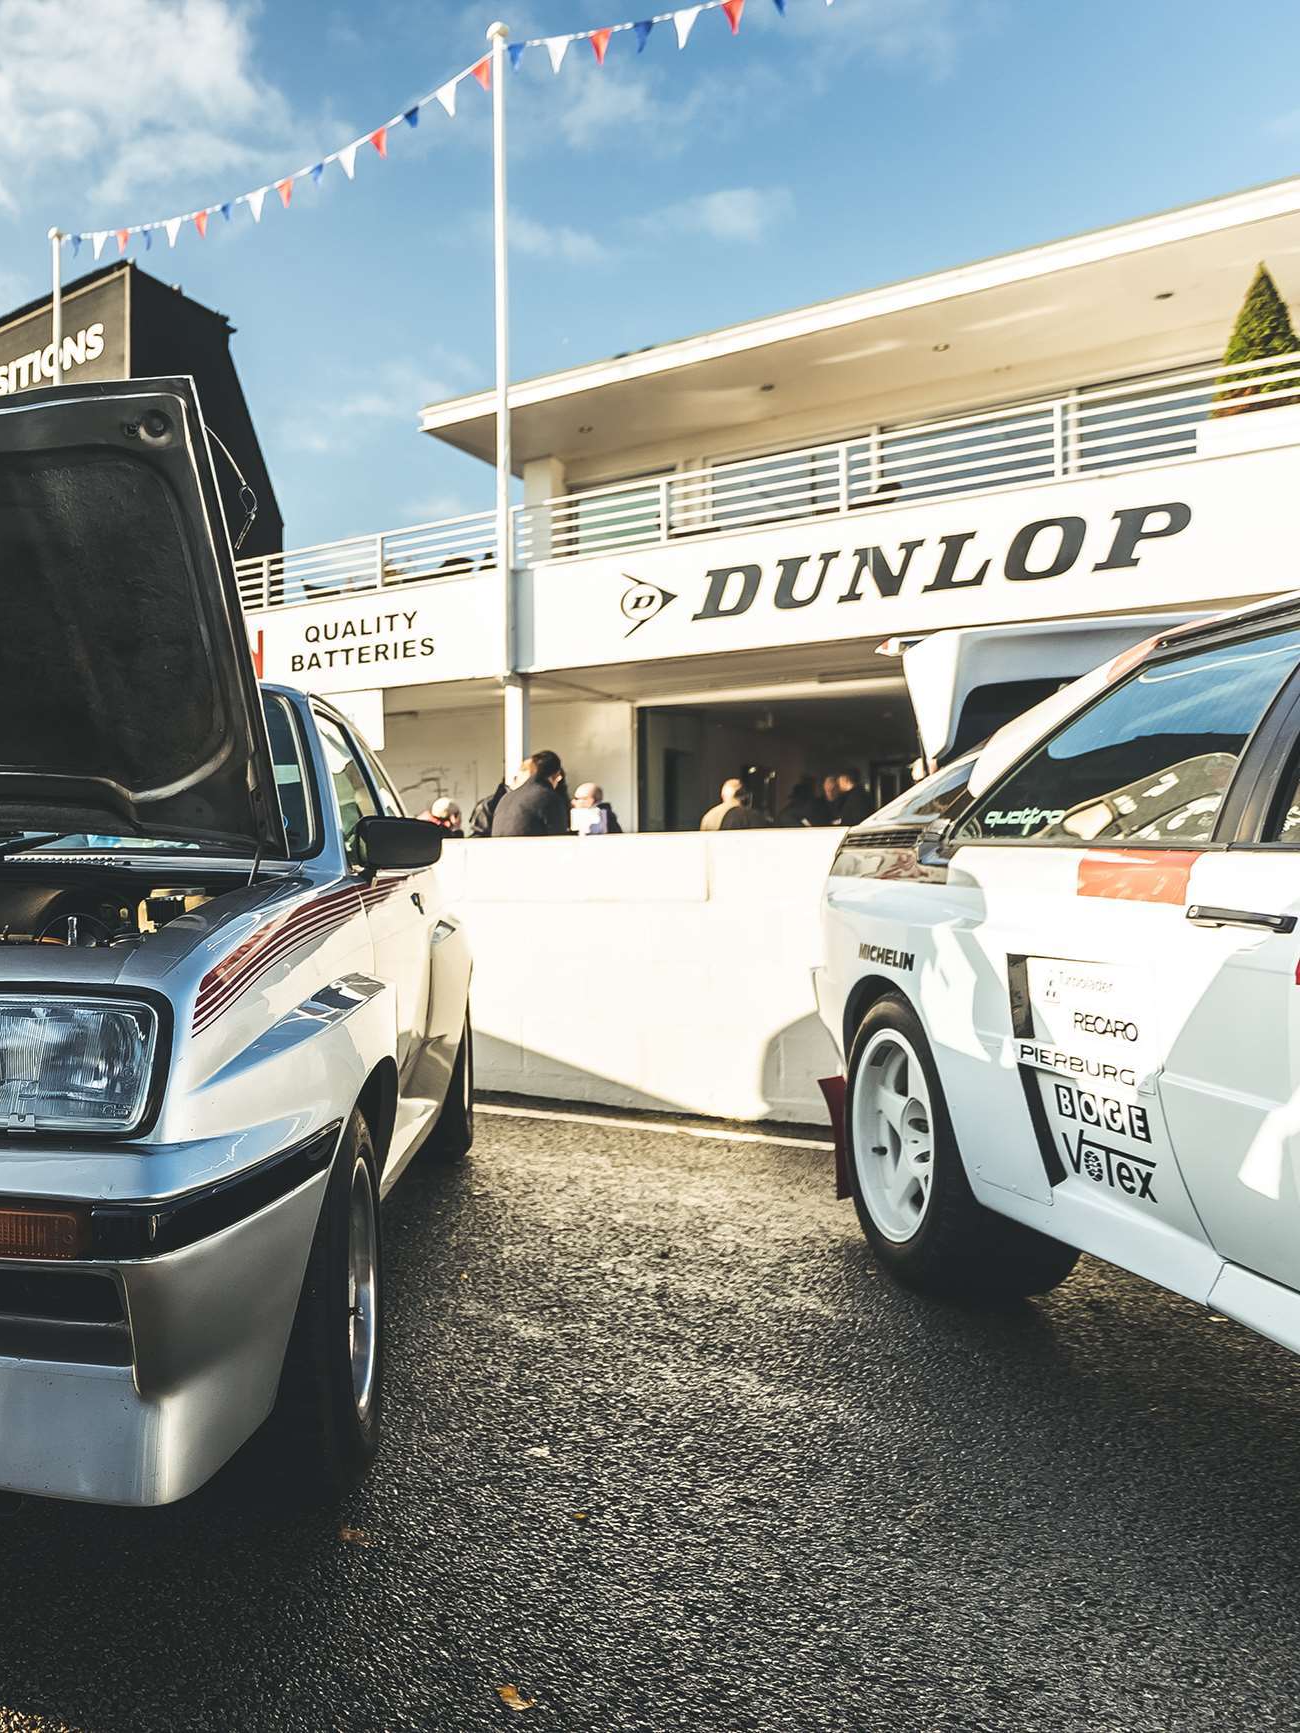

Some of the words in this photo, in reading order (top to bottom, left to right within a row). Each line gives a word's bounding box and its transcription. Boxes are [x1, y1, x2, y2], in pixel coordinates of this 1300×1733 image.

[691, 501, 1192, 622] DUNLOP
[304, 610, 418, 644] QUALITY
[291, 637, 436, 673] BATTERIES
[984, 807, 1067, 836] quattro
[858, 943, 916, 972] MICHELIN
[1073, 1011, 1139, 1042] RECARO
[1020, 1043, 1136, 1087] PIERBURG
[1055, 1084, 1151, 1143] BOGE
